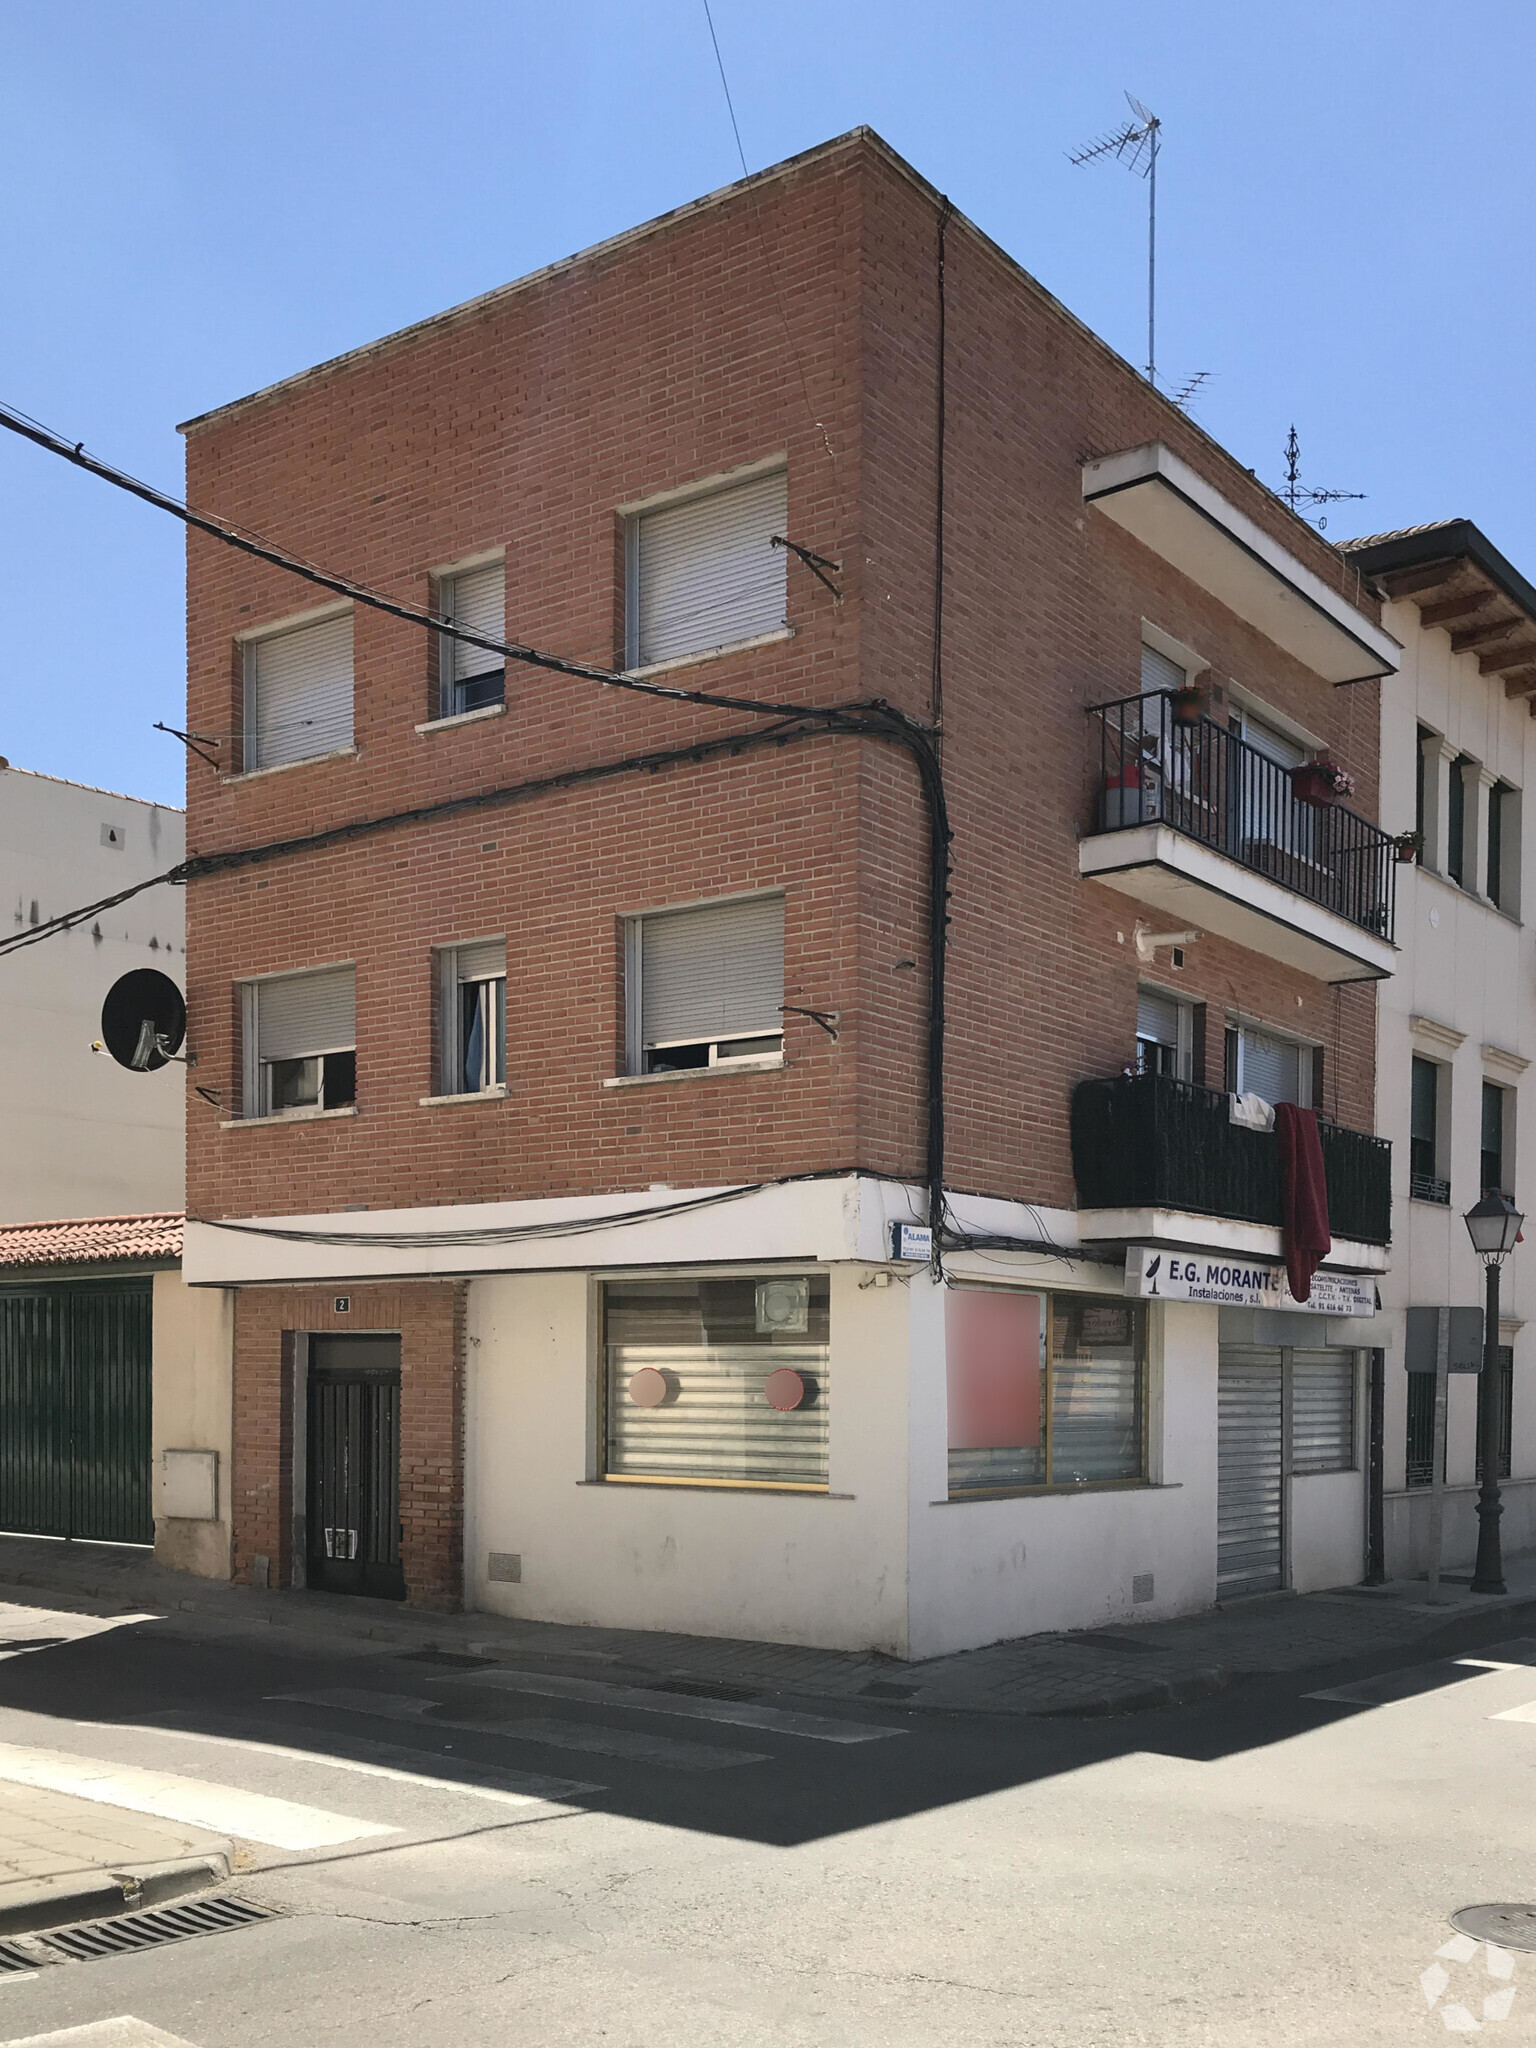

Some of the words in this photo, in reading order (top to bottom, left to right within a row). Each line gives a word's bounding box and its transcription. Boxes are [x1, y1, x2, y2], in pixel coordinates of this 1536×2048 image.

[1169, 1260, 1200, 1283] E.G.
[1206, 1265, 1279, 1291] MORANTE
[1311, 1275, 1358, 1287] ECOMUNICACIONES
[1339, 1287, 1361, 1295] ANTENAS
[340, 1300, 345, 1310] 2
[1353, 1296, 1373, 1304] DIGITAL
